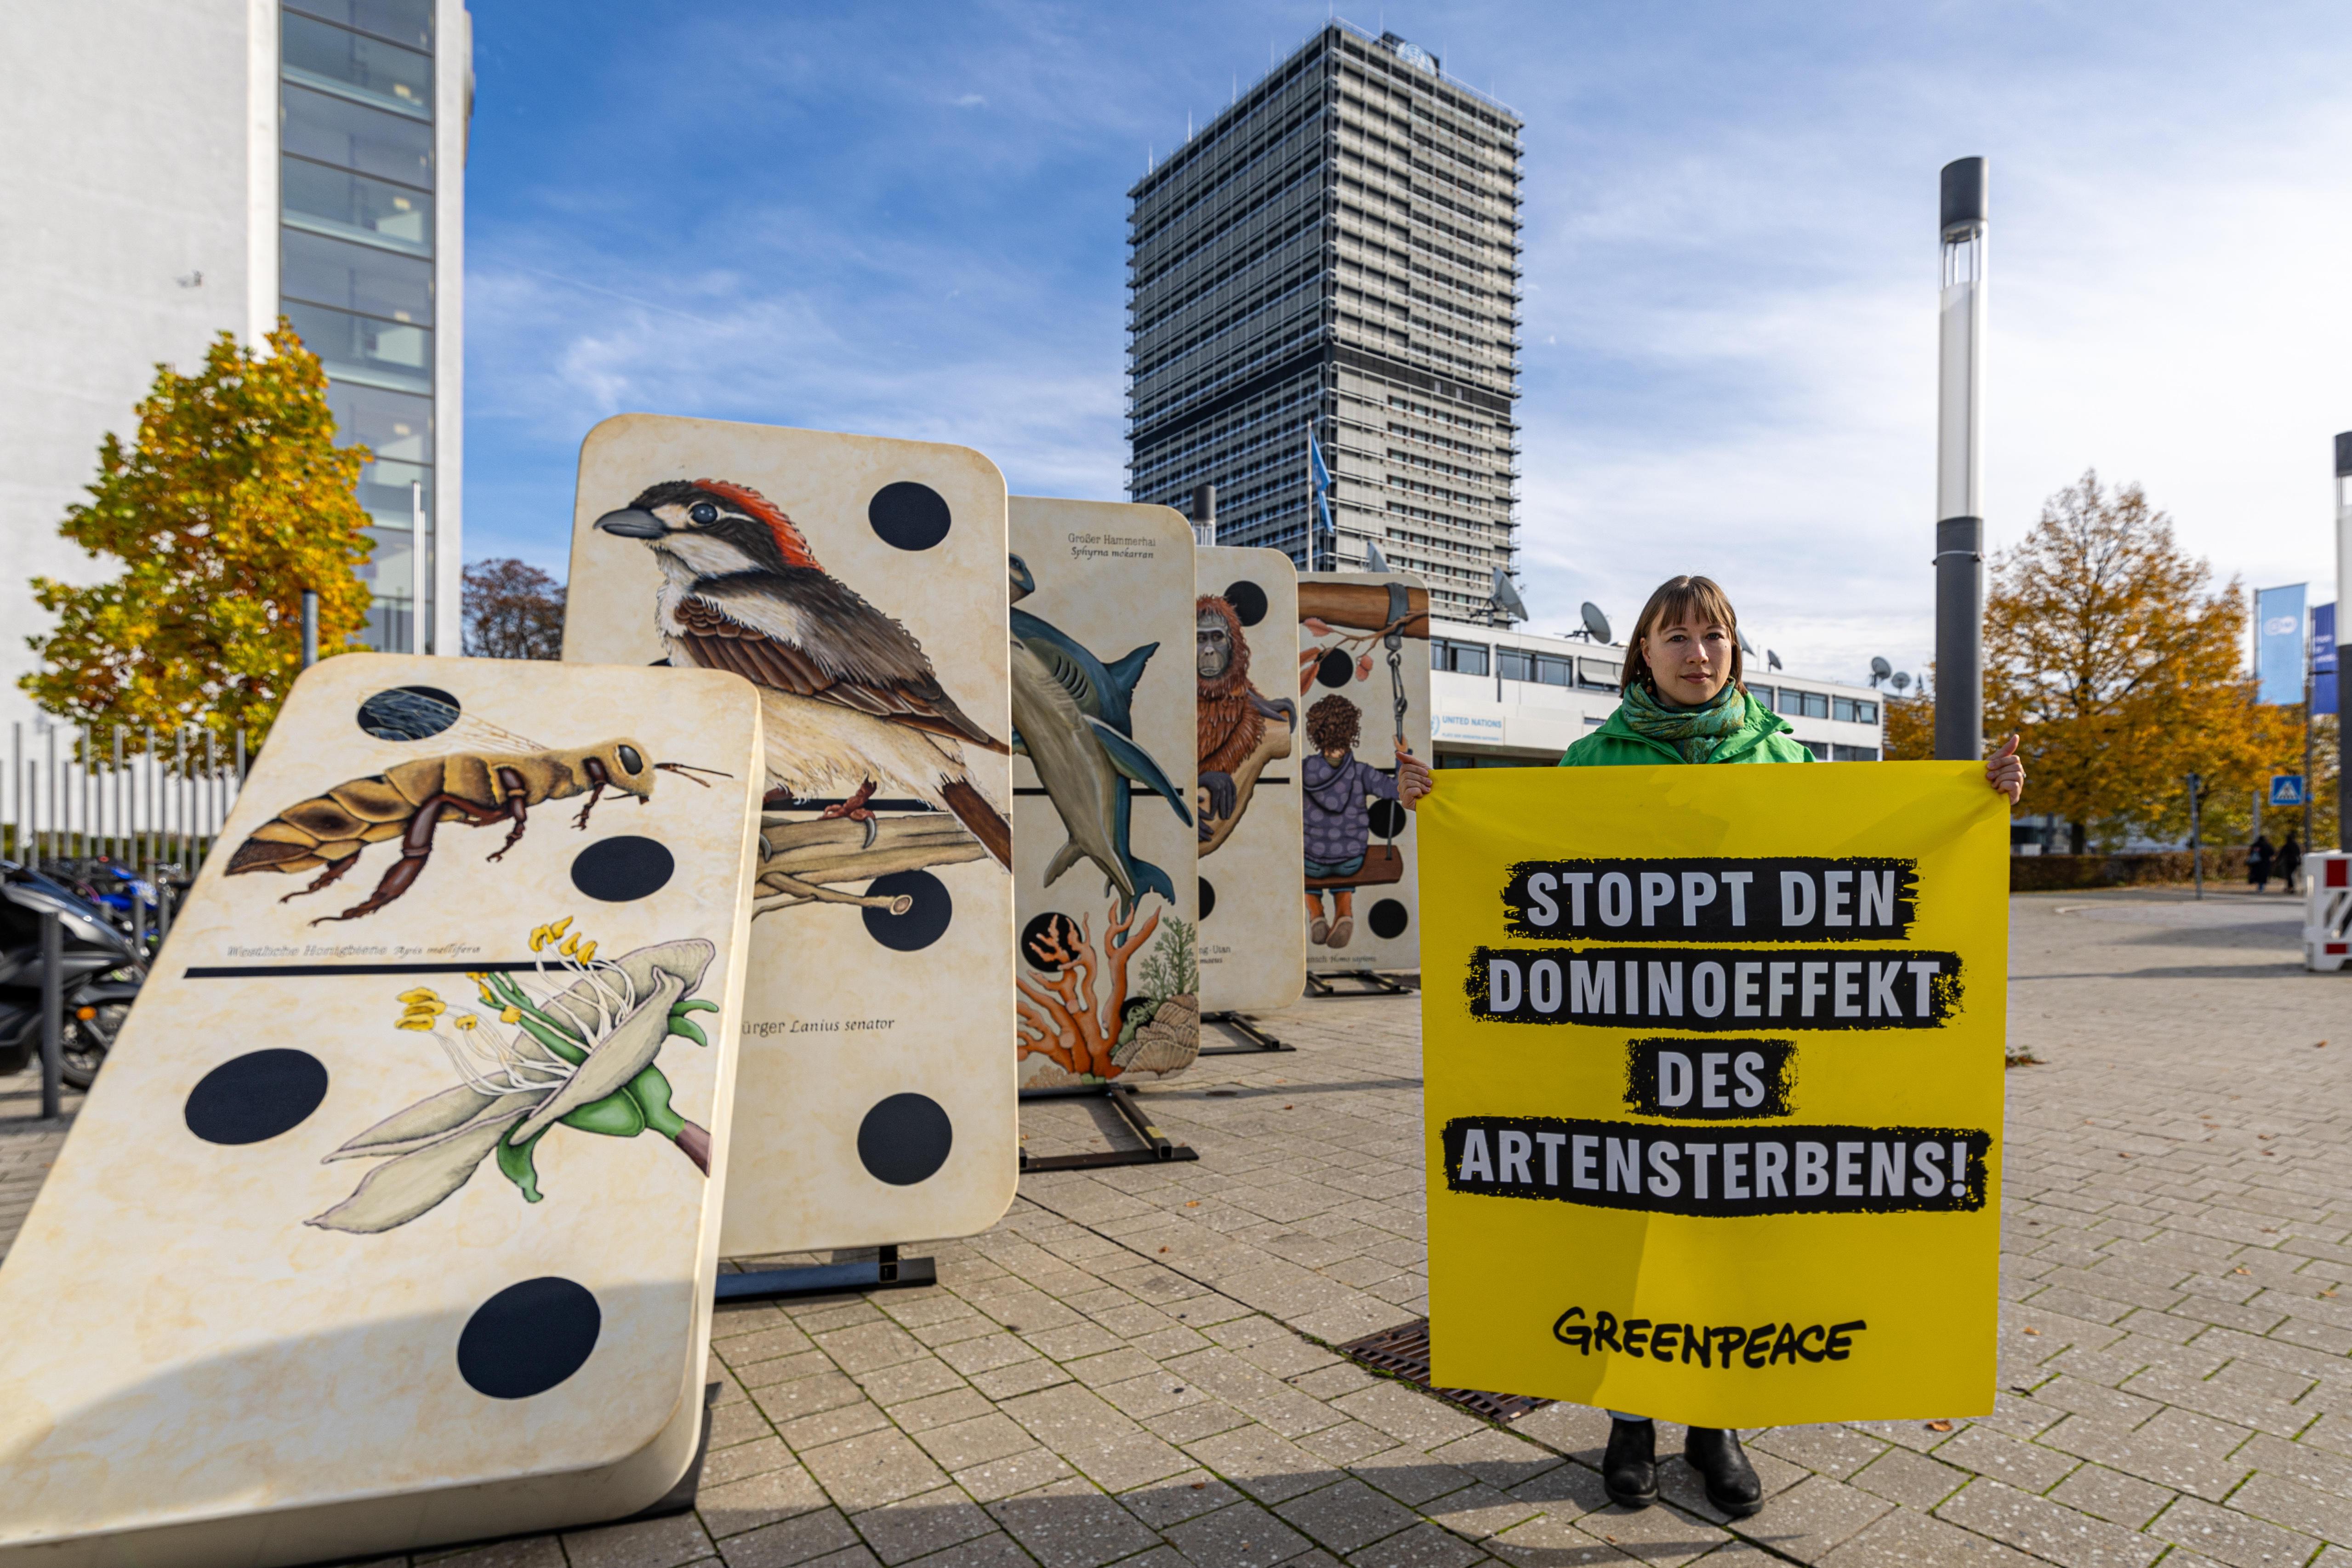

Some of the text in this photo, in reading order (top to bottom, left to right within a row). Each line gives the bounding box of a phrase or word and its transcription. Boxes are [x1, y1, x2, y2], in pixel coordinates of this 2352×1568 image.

[1068, 533, 1156, 547] Großer Hammerhai
[1071, 545, 1109, 560] Sphyrna
[1442, 716, 1502, 728] UNITED NATIONS
[1527, 870, 1895, 927] STOPPT DEN
[303, 945, 387, 958] Honigbiene
[427, 943, 481, 958] mellifera
[1488, 958, 1940, 1018] DOMINOEFFEKT
[790, 1019, 840, 1033] Lanius
[844, 1019, 895, 1031] senator
[1658, 1051, 1765, 1108] DES
[1459, 1129, 1967, 1200] ARTENSTERBENS!
[1553, 1306, 1867, 1369] GREENPEACE
